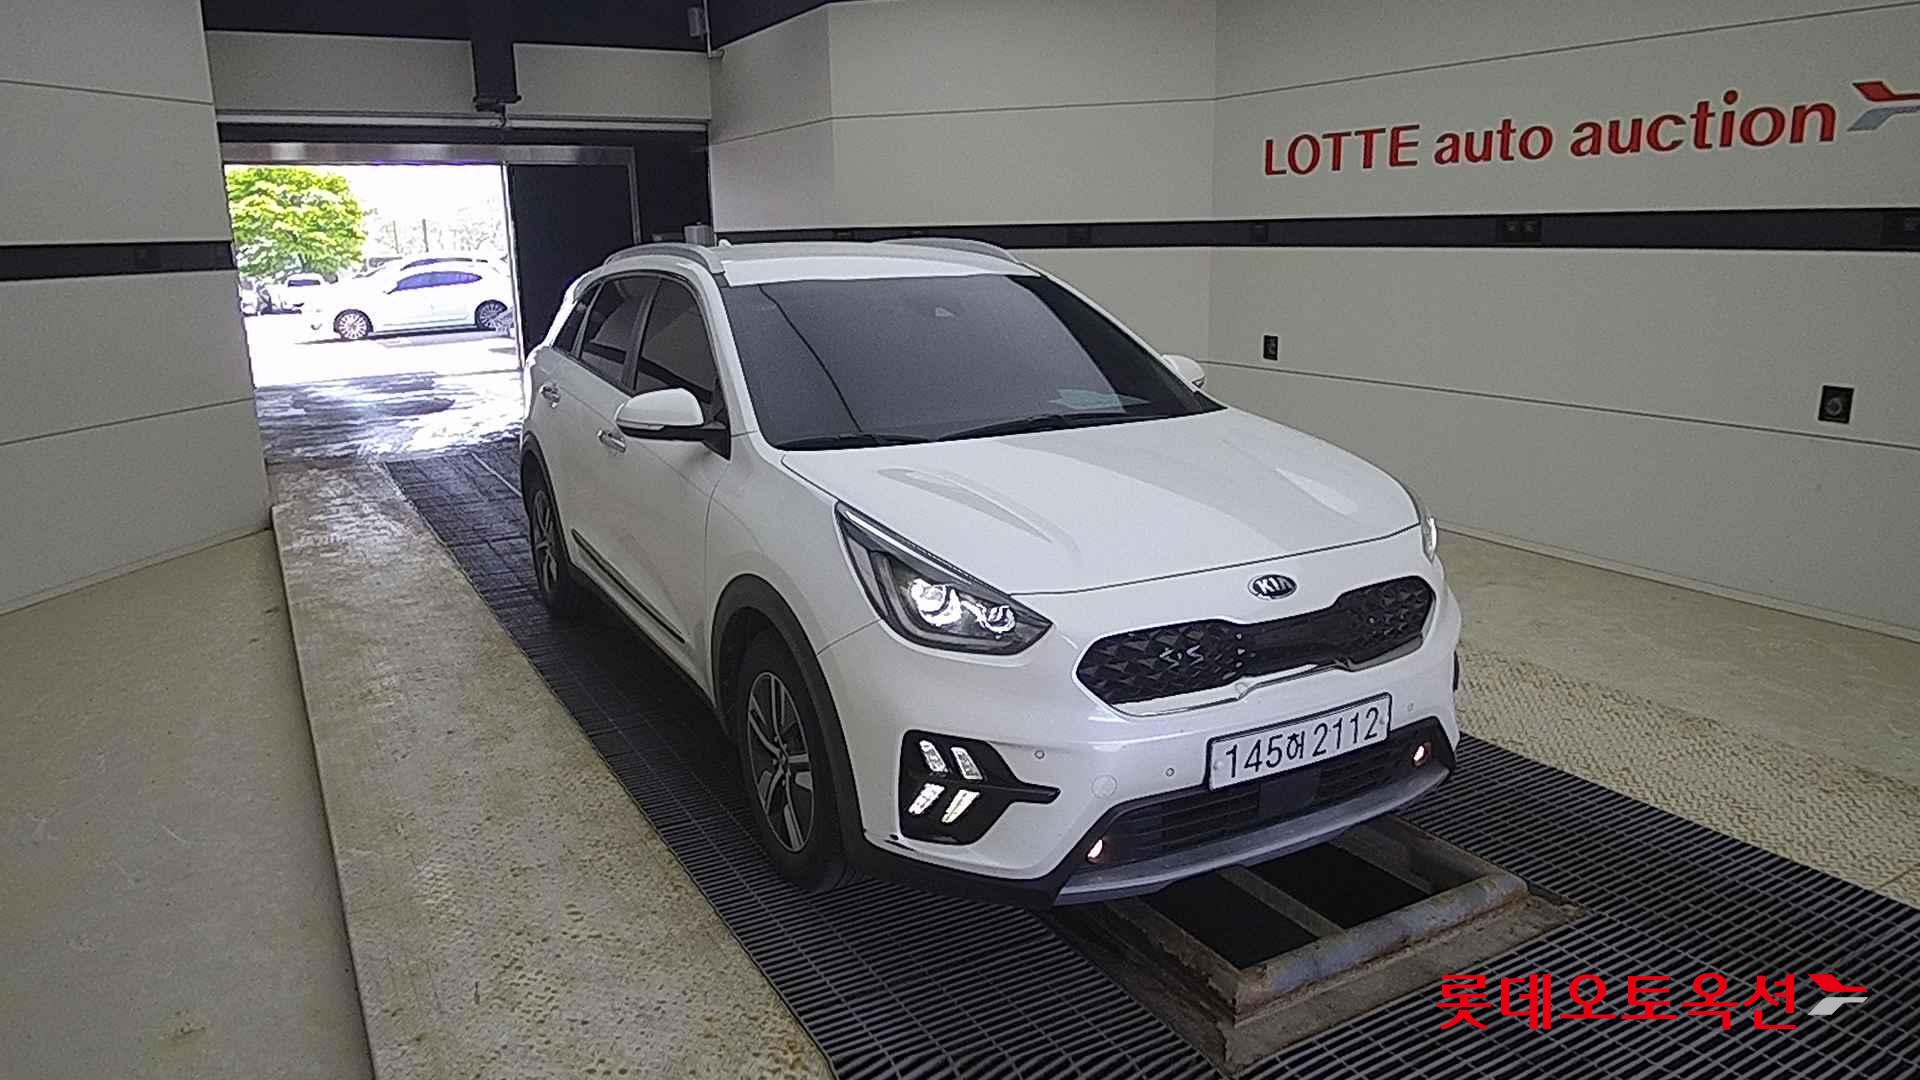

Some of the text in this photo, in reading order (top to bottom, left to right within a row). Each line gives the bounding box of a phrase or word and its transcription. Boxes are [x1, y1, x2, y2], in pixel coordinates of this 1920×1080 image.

[1263, 89, 1838, 177] LOTTE auto auction
[1255, 576, 1293, 595] KIA
[1225, 706, 1380, 778] 145허 2112
